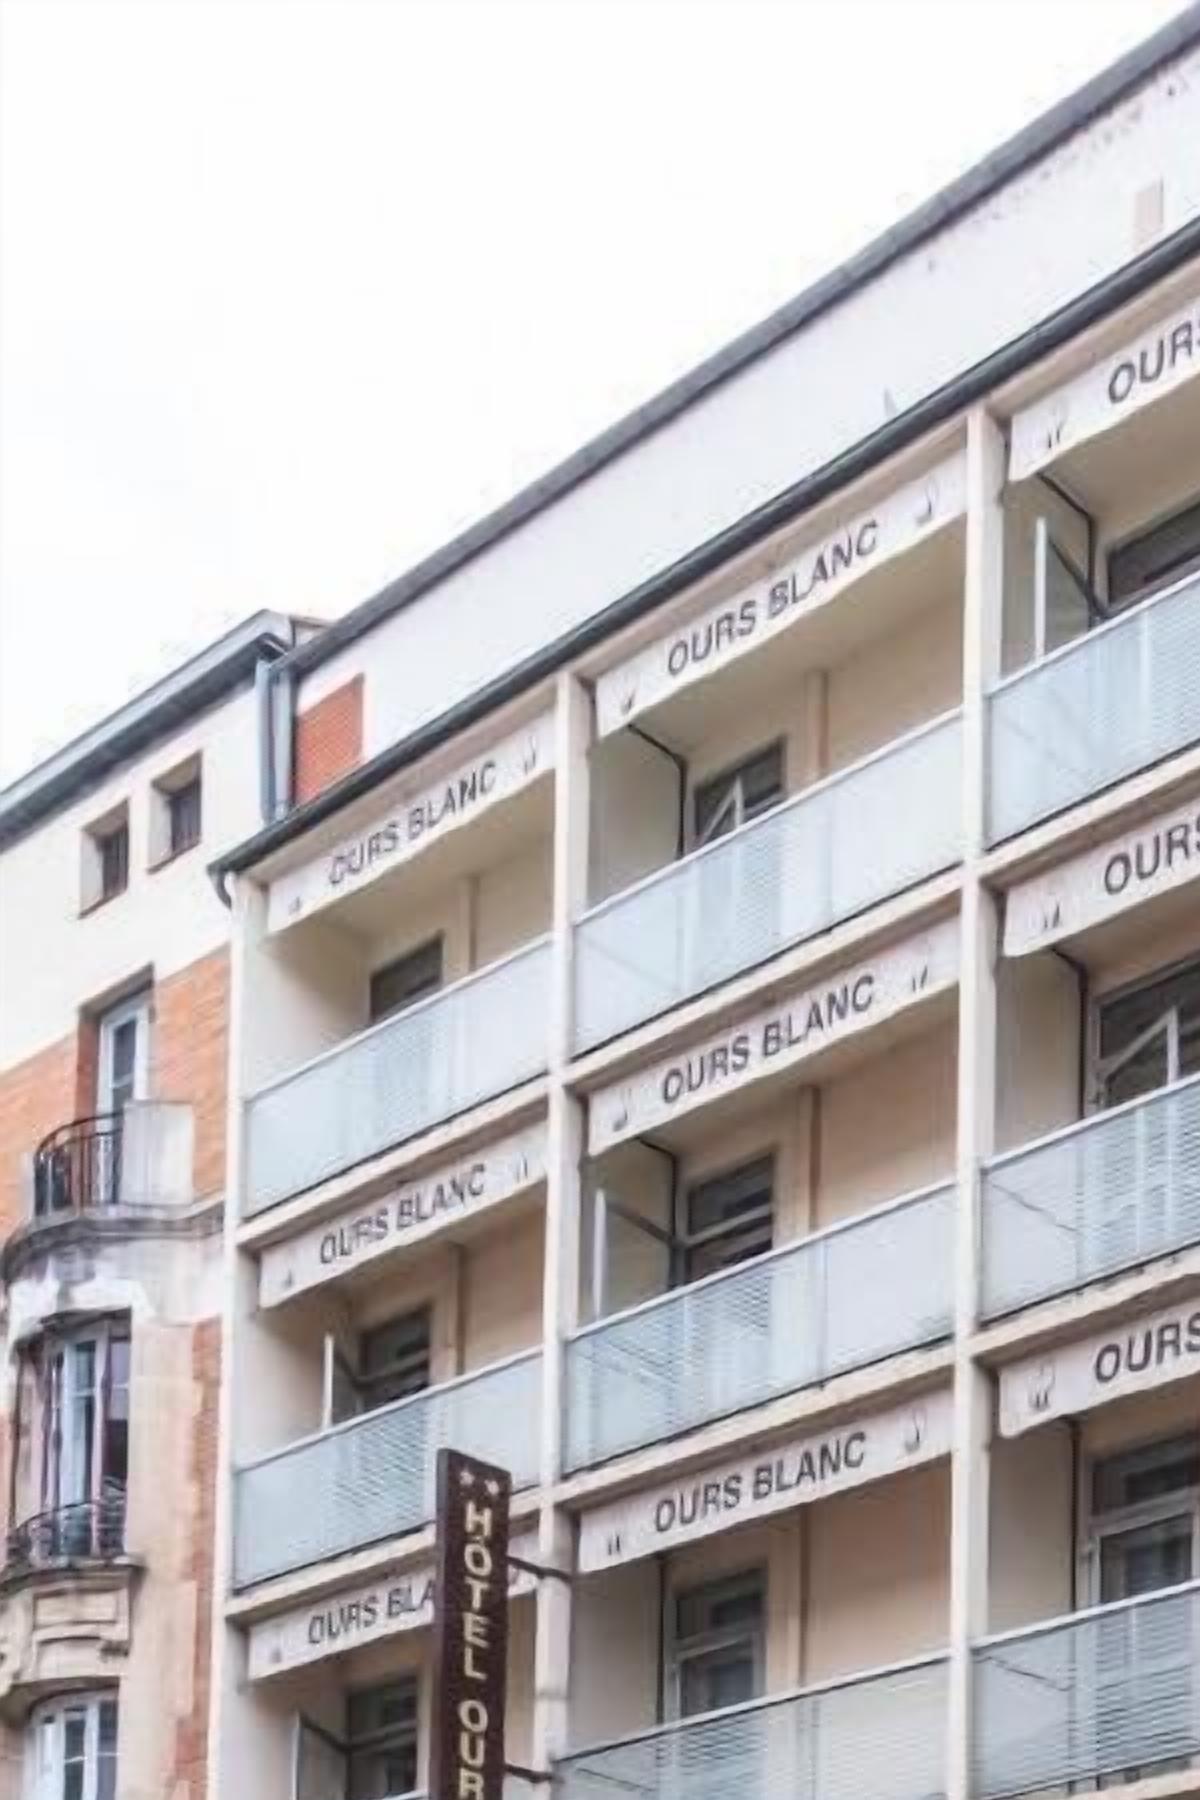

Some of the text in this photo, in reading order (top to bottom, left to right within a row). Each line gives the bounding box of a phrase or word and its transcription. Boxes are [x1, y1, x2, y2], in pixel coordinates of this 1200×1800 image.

[668, 520, 878, 676] OURS BLANC
[407, 761, 495, 842] BLANC
[663, 976, 874, 1103] OURS BLANC
[397, 1164, 485, 1230] BLANC
[655, 1432, 866, 1533] OURS BLANC
[460, 1502, 493, 1681] HOTEL
